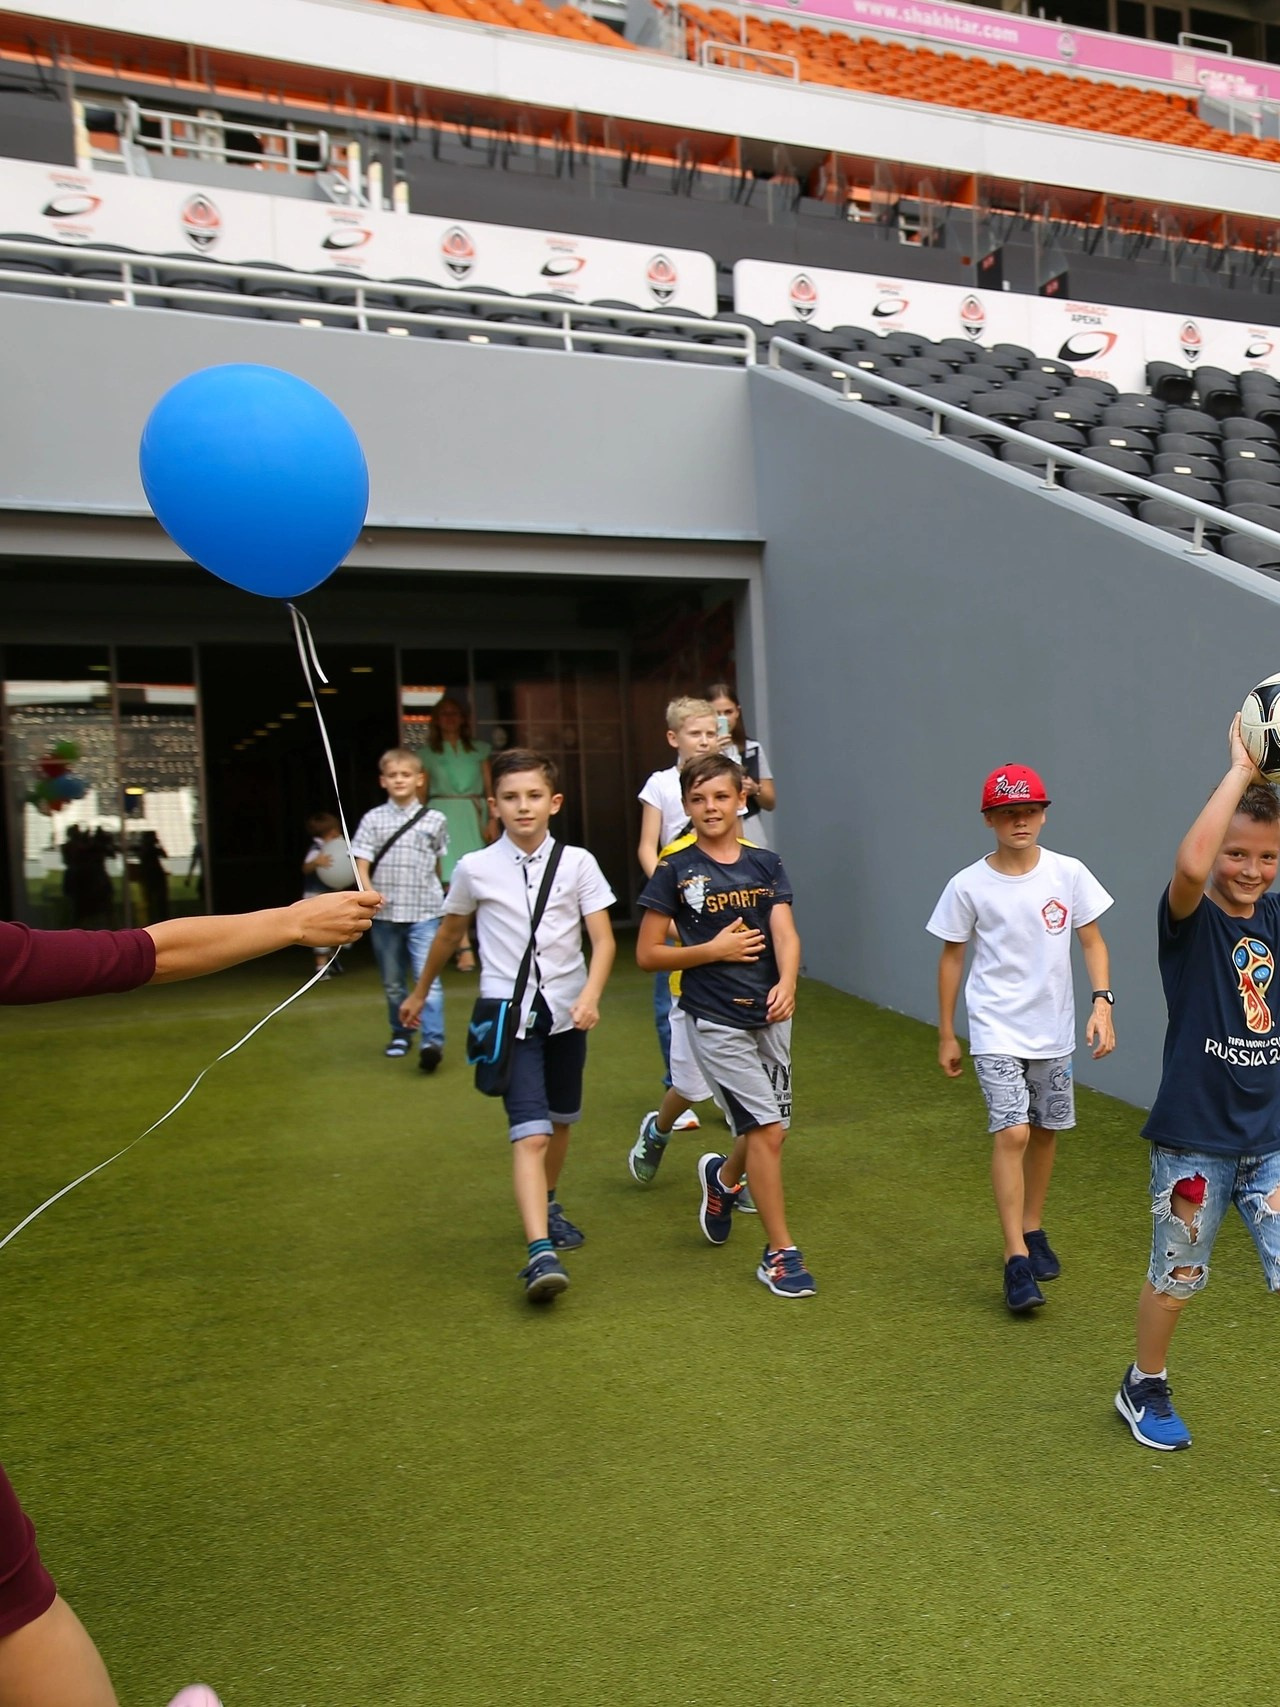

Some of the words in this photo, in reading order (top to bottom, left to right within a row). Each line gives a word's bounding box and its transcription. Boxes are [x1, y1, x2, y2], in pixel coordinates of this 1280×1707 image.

[853, 0, 1019, 43] www.shakhtar.com
[1204, 1037, 1268, 1067] RUSSIA
[1228, 1035, 1245, 1047] FIFA
